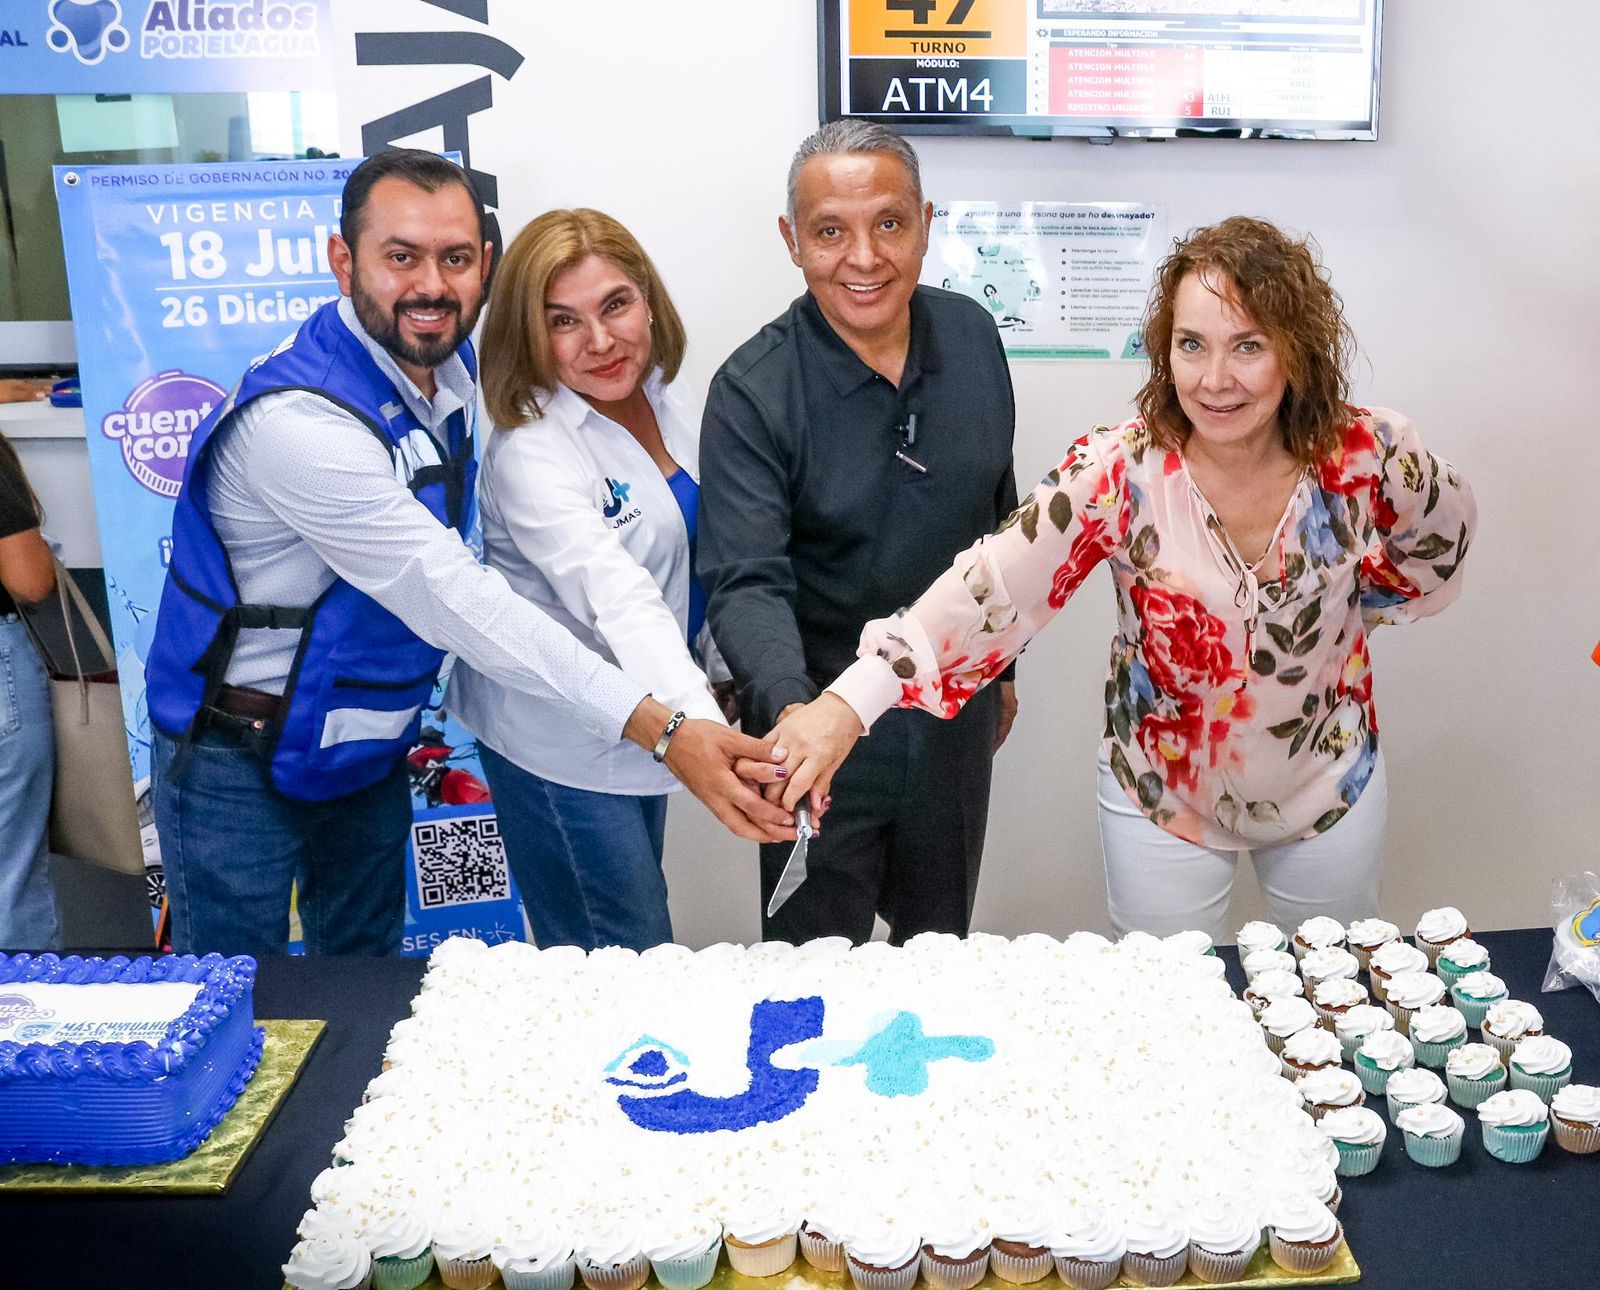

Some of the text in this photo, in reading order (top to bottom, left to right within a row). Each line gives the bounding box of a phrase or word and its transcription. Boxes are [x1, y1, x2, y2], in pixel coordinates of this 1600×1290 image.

[144, 0, 315, 32] Aliados
[1063, 30, 1107, 38] ESPERANDO
[143, 35, 316, 56] POR EL AGUA
[910, 41, 967, 55] TURNO
[1068, 49, 1154, 58] ATENCION MULTIPLE
[915, 59, 960, 69] MÓDULO:
[1067, 63, 1110, 71] ATENCION
[1067, 76, 1110, 84] ATENCION
[881, 76, 995, 112] ATM4
[1067, 103, 1110, 112] REGISTRO
[1184, 105, 1192, 115] 5
[91, 174, 159, 187] PERMISO
[164, 174, 185, 185] DE
[189, 169, 299, 184] GOBERNACIÓN
[304, 170, 328, 181] NO.
[146, 199, 315, 224] VIGENCIA
[1030, 210, 1058, 218] rsona
[1059, 211, 1076, 220] que
[1088, 210, 1100, 219] ha
[159, 224, 341, 280] 18 Jul
[160, 295, 208, 328] 26
[612, 507, 642, 529] JMAS
